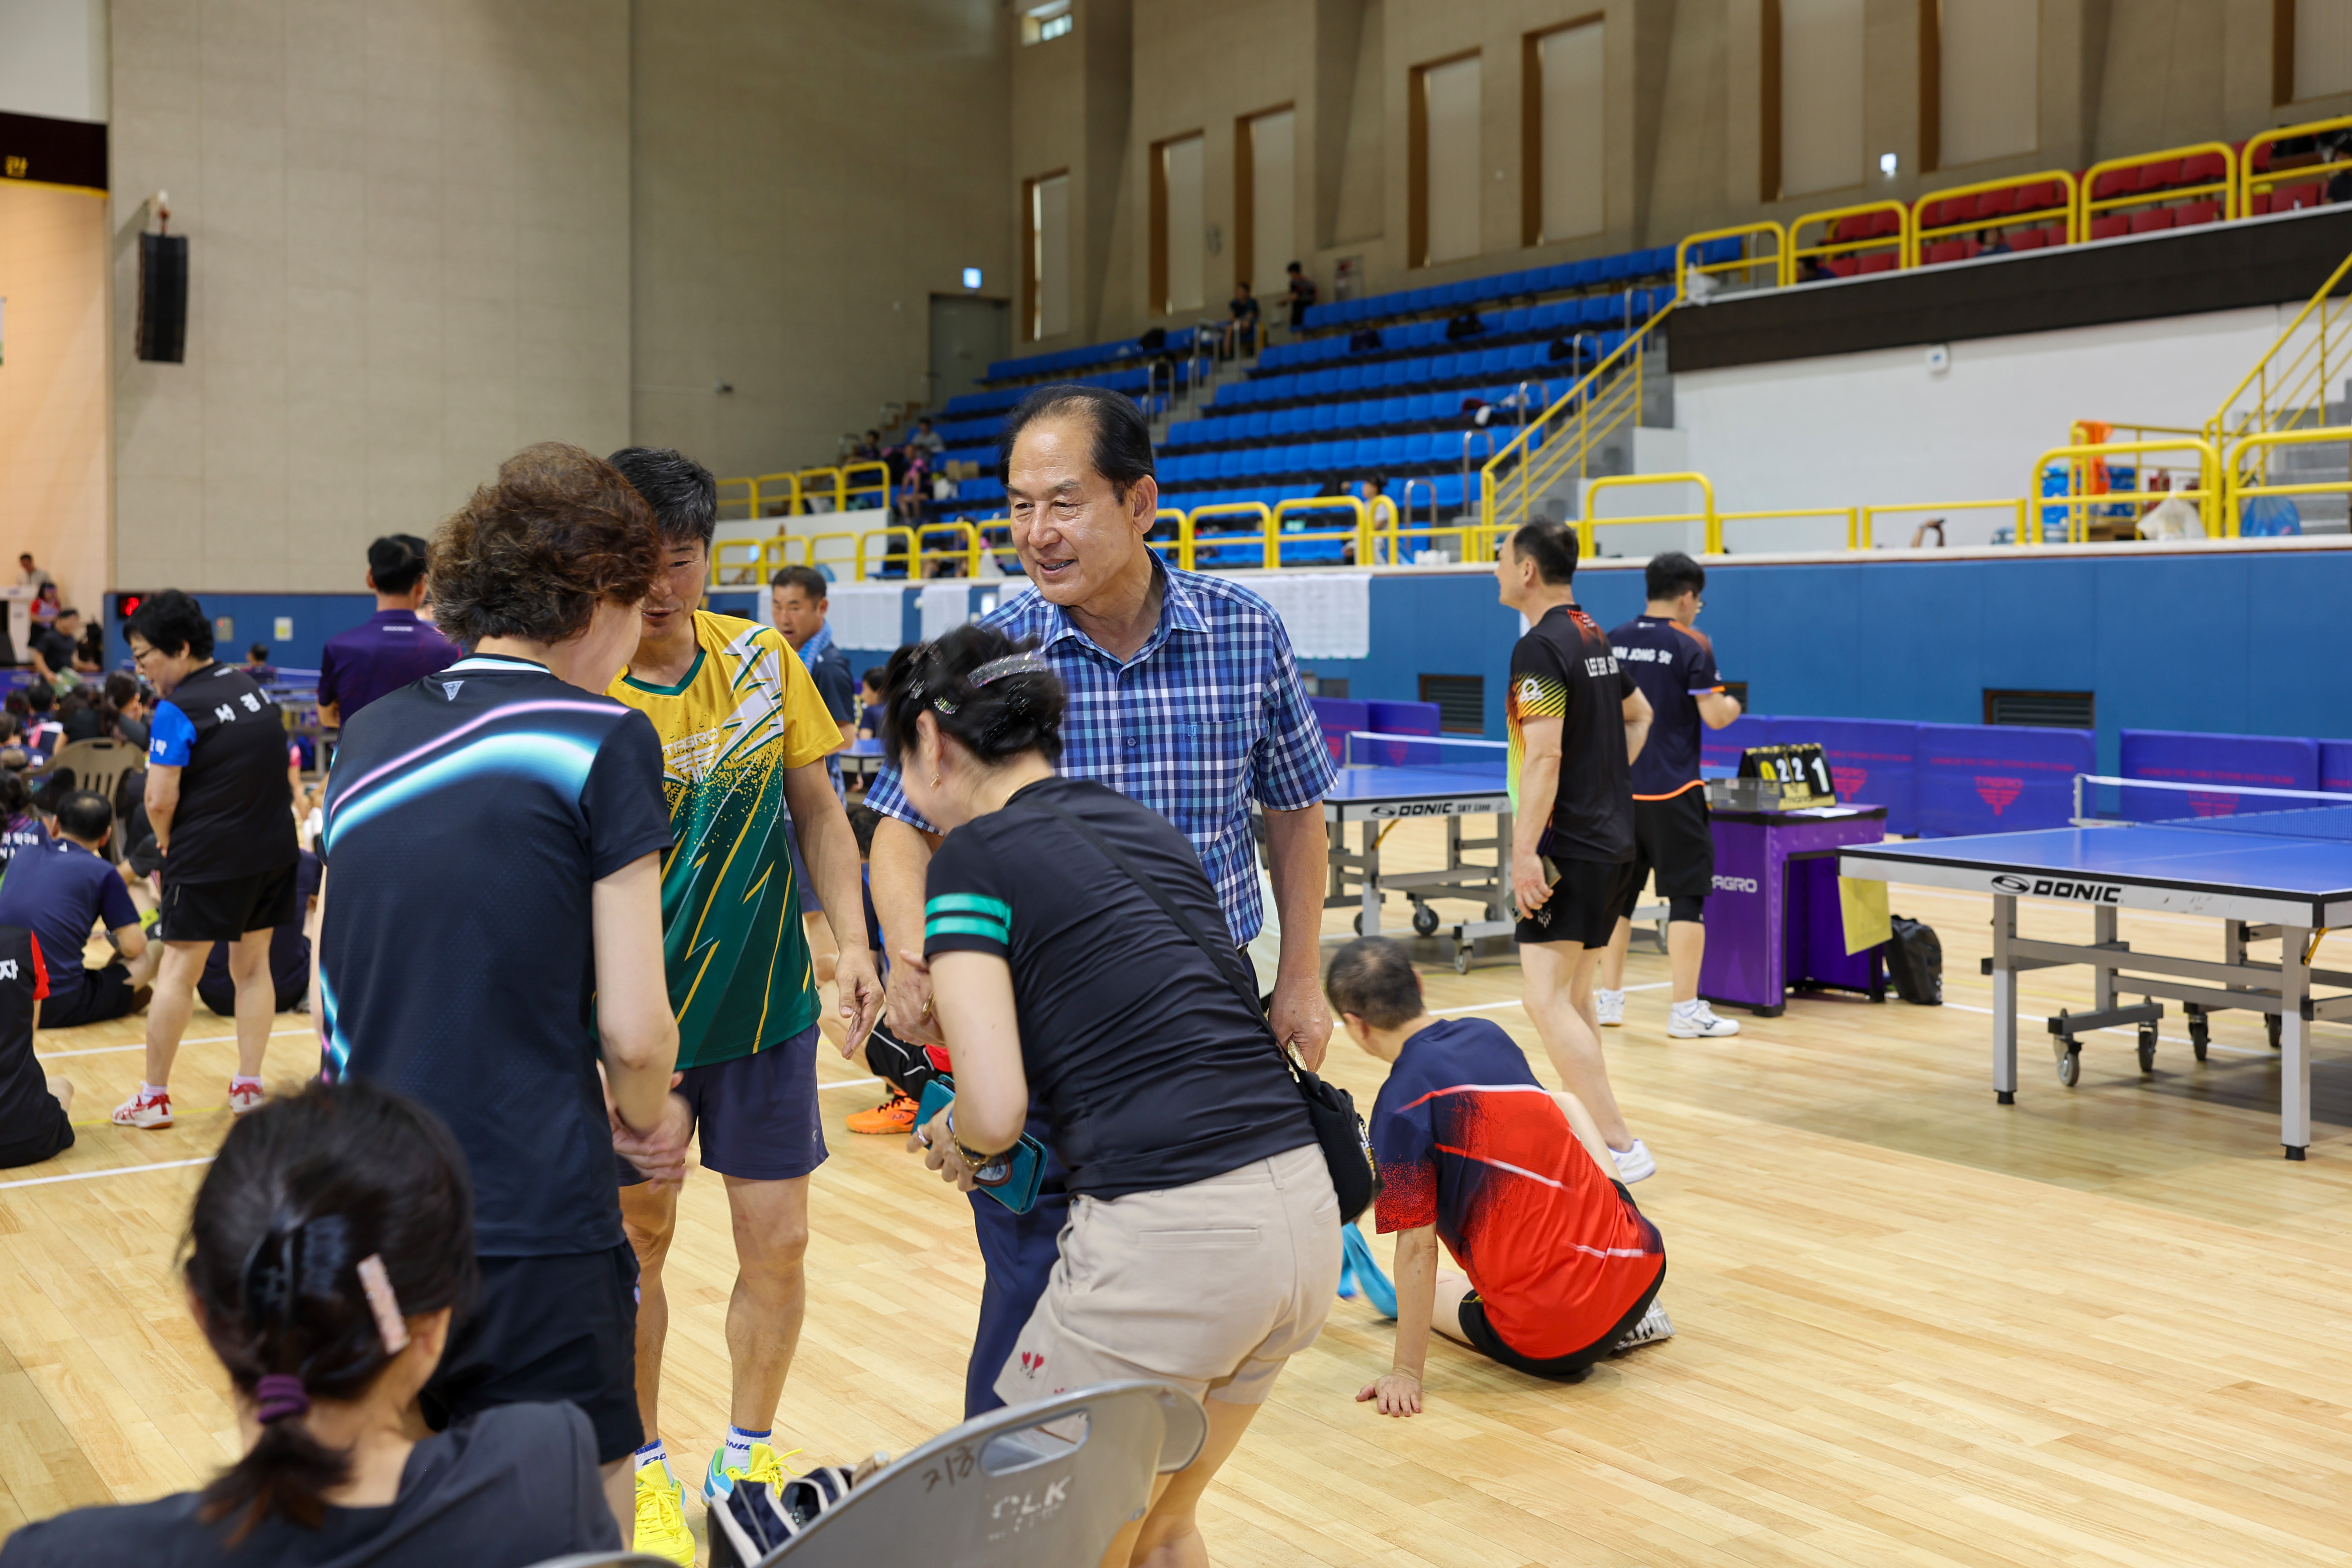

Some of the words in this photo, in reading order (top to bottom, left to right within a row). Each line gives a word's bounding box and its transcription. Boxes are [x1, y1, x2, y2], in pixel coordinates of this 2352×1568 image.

[662, 728, 719, 755] TAGRO
[1776, 759, 1791, 782] 2
[1791, 757, 1806, 781] 2
[1811, 757, 1830, 793] 1
[1399, 803, 1452, 816] DONIC
[1711, 874, 1758, 893] AGRO
[2033, 880, 2121, 903] DONIC
